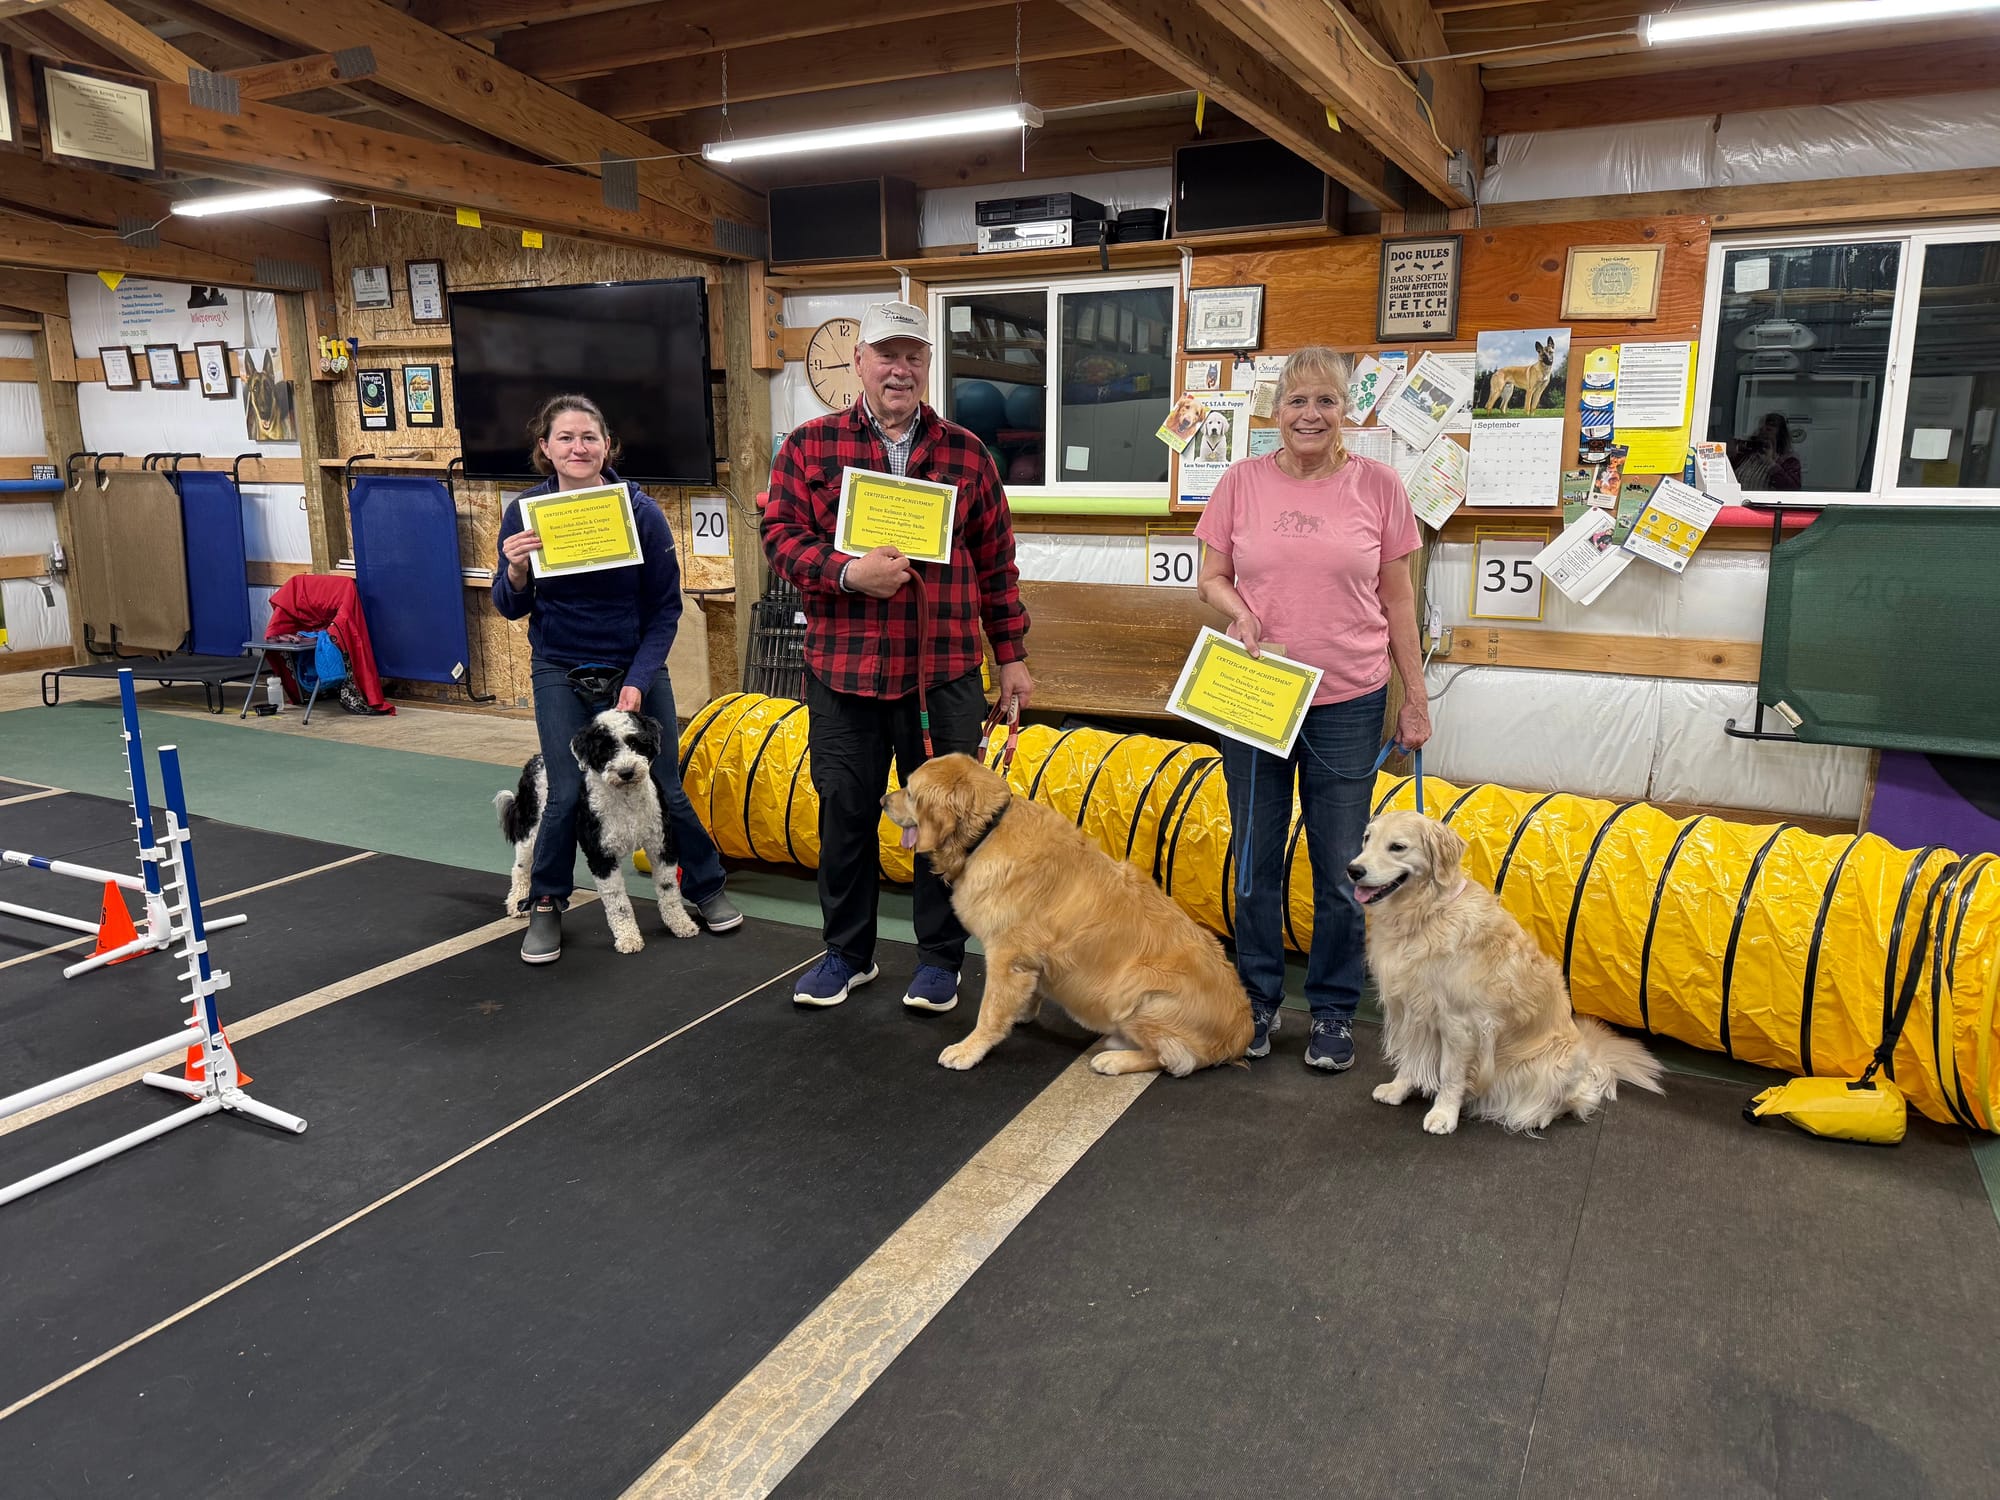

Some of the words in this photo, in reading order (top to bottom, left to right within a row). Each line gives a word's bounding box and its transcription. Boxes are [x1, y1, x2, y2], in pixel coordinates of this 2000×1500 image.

[1391, 252, 1412, 260] DOG
[1416, 248, 1449, 259] RULES
[1416, 273, 1448, 281] SOFTLY
[1412, 282, 1448, 290] AFFECTION
[1389, 298, 1447, 311] FETCH
[840, 325, 850, 336] 12
[844, 394, 850, 405] 6
[1478, 422, 1520, 430] September
[864, 491, 893, 500] CERTIFICATE
[902, 498, 934, 506] ACHIEVEMENT
[696, 512, 724, 537] 20
[1153, 552, 1193, 582] 30
[1484, 560, 1532, 593] 35
[1216, 655, 1247, 670] CERTIFICATE
[1257, 670, 1291, 686] ACHIEVEMENT
[1213, 681, 1243, 694] Intermediate
